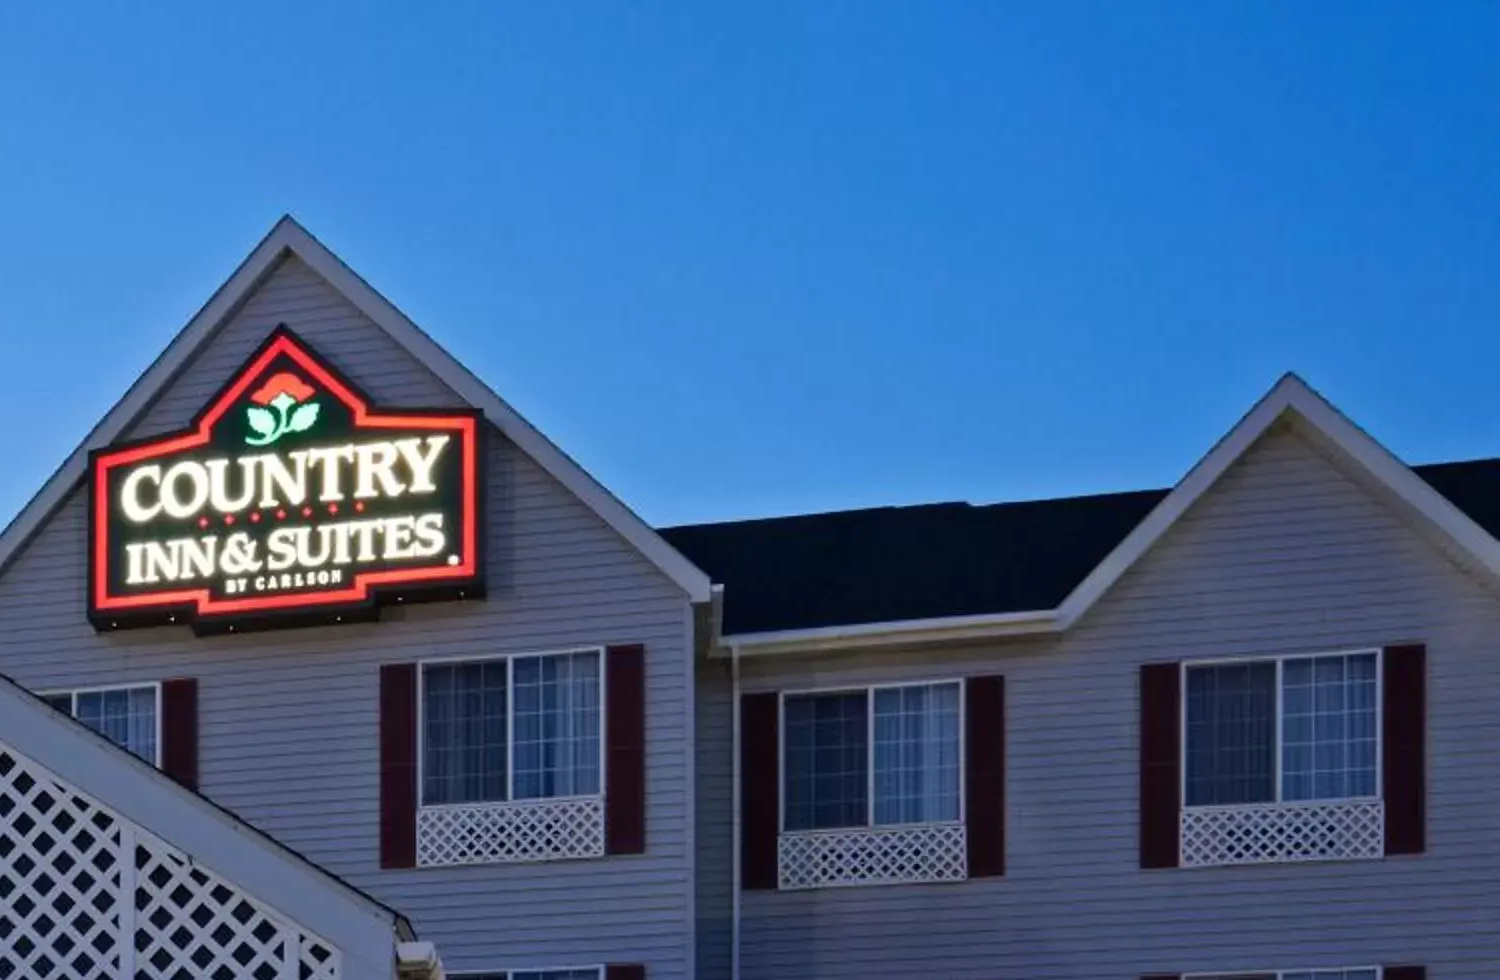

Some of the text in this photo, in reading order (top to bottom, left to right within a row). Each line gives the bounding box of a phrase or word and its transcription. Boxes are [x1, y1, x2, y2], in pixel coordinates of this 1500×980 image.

[120, 434, 450, 523] COUNTRY
[224, 569, 343, 594] BY CARLSON
